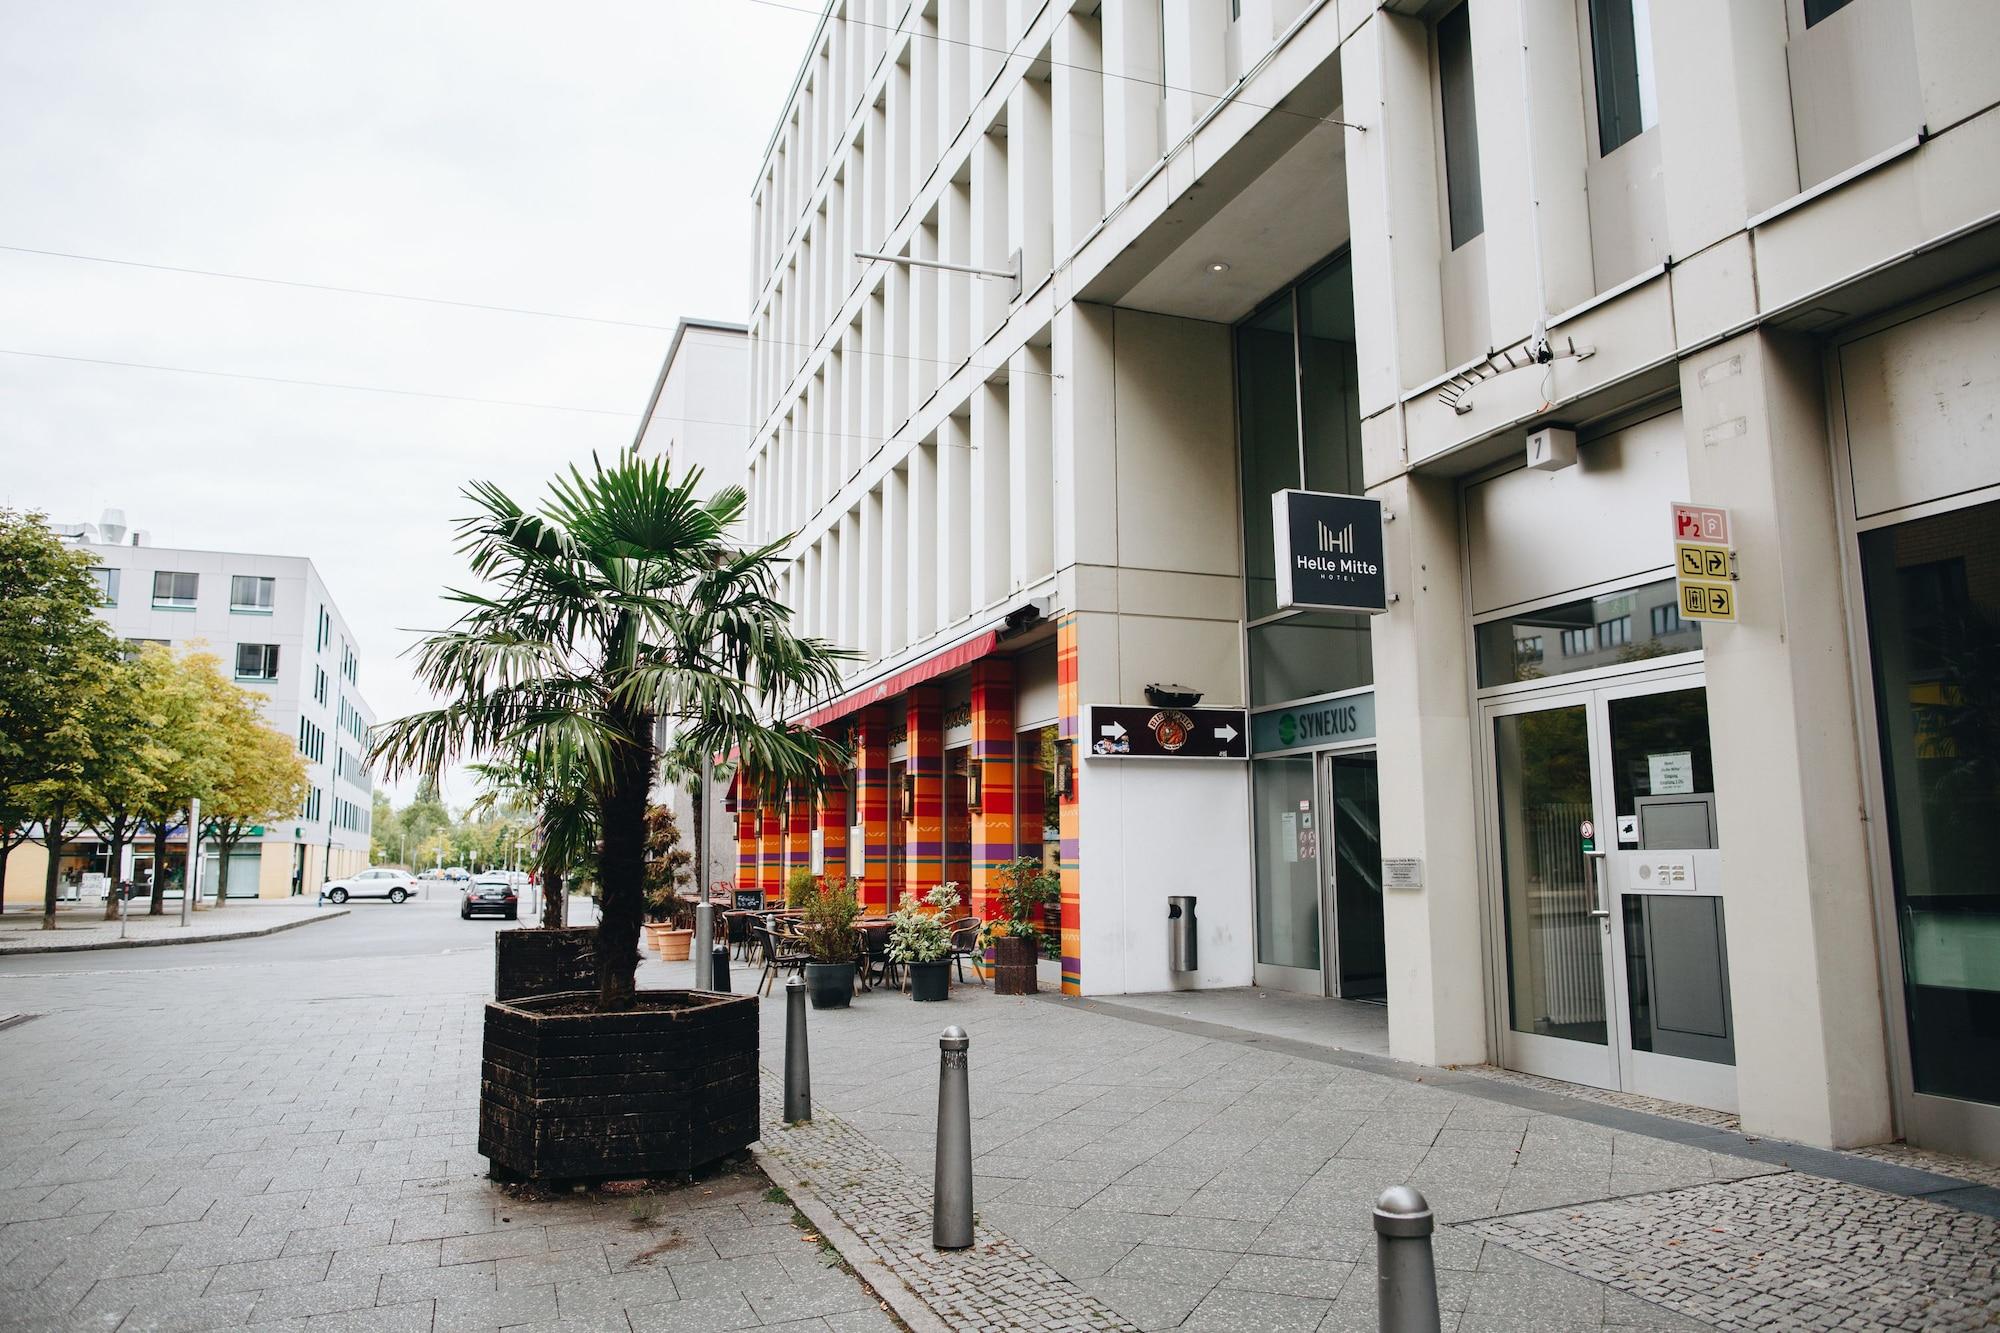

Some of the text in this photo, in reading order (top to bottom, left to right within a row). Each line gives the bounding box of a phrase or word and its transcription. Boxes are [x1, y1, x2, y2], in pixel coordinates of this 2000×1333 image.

[1535, 437, 1542, 460] 7
[1296, 555, 1378, 576] Helle Mitte
[1320, 574, 1356, 582] HOTEL
[1149, 710, 1194, 730] BIERNIG
[1299, 705, 1357, 740] SYNEXUS
